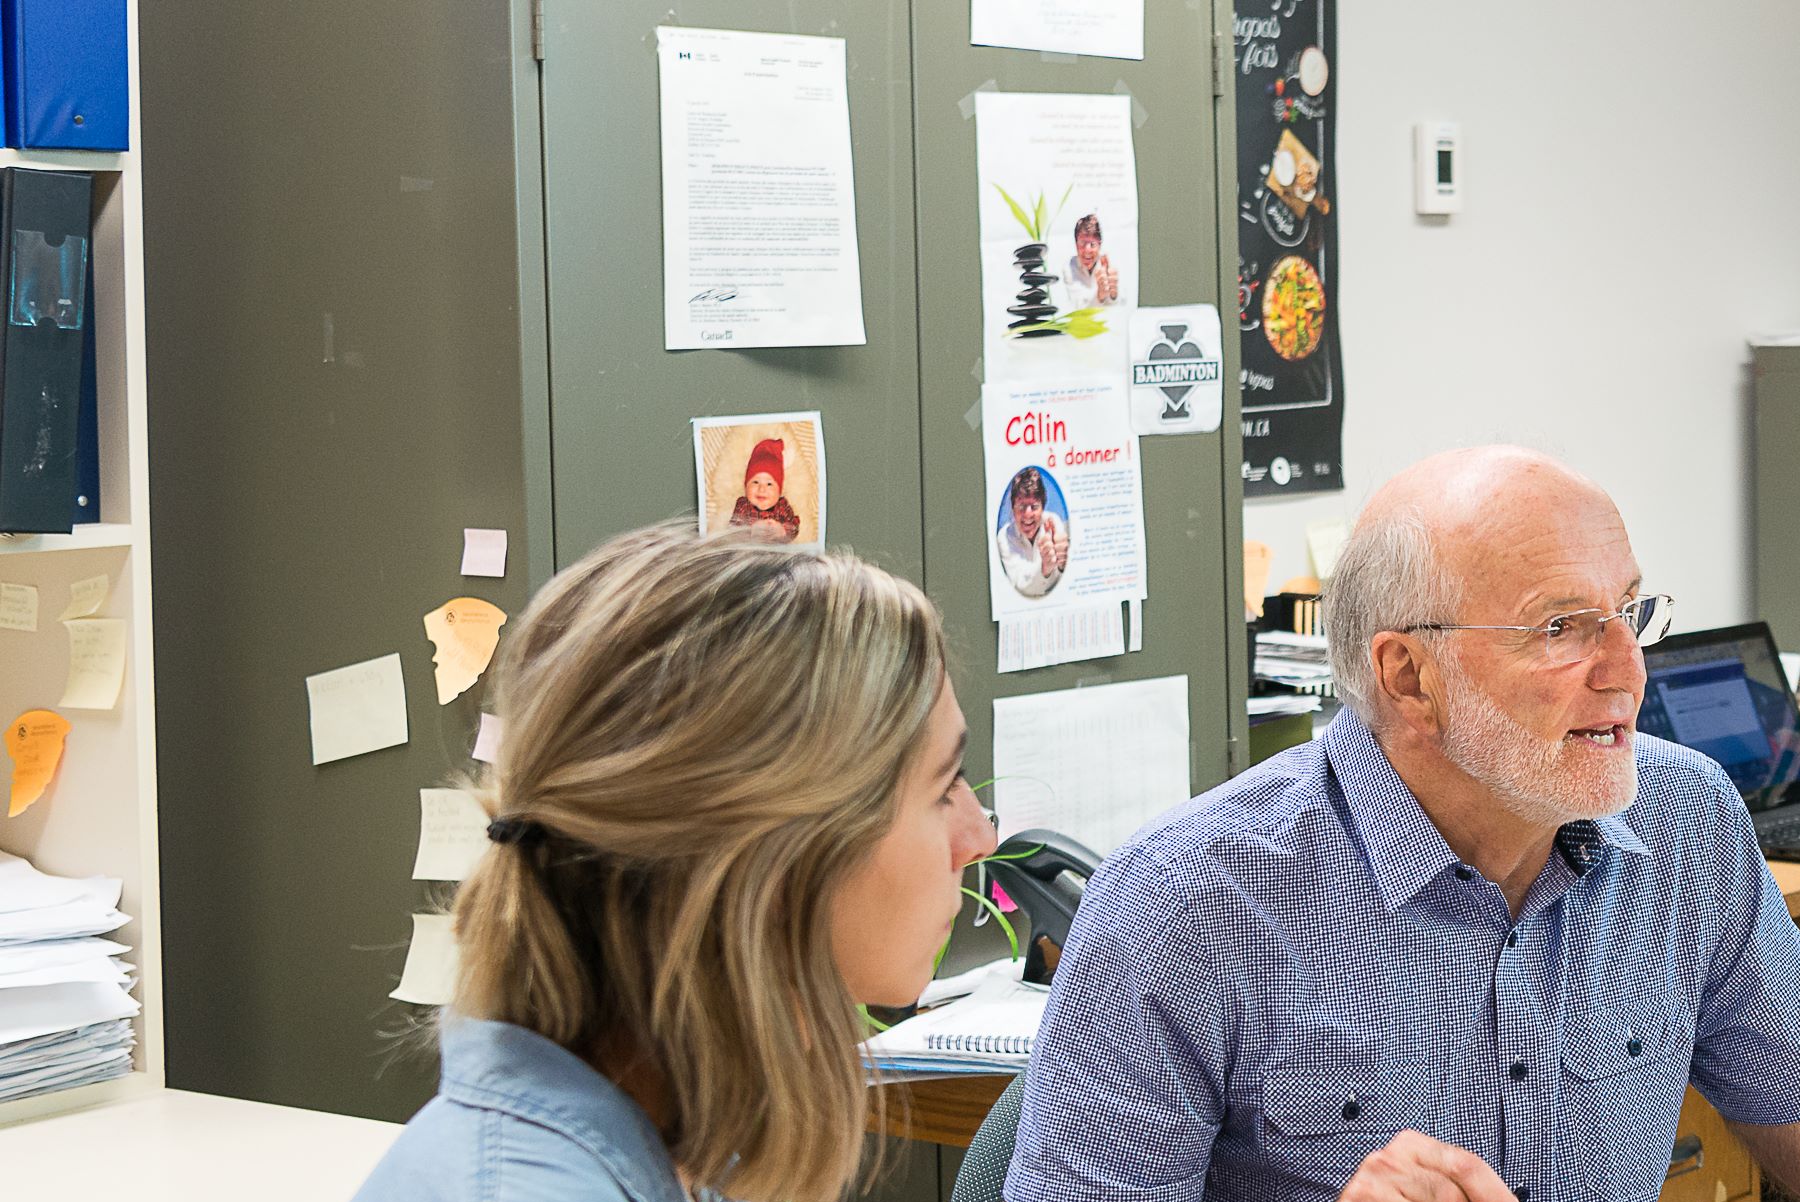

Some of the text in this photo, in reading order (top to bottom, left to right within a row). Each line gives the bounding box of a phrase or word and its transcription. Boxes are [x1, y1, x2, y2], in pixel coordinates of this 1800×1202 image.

[1134, 362, 1217, 384] BADMINTON
[1005, 411, 1067, 446] Câlin
[1047, 447, 1057, 468] à
[1064, 445, 1120, 466] donner
